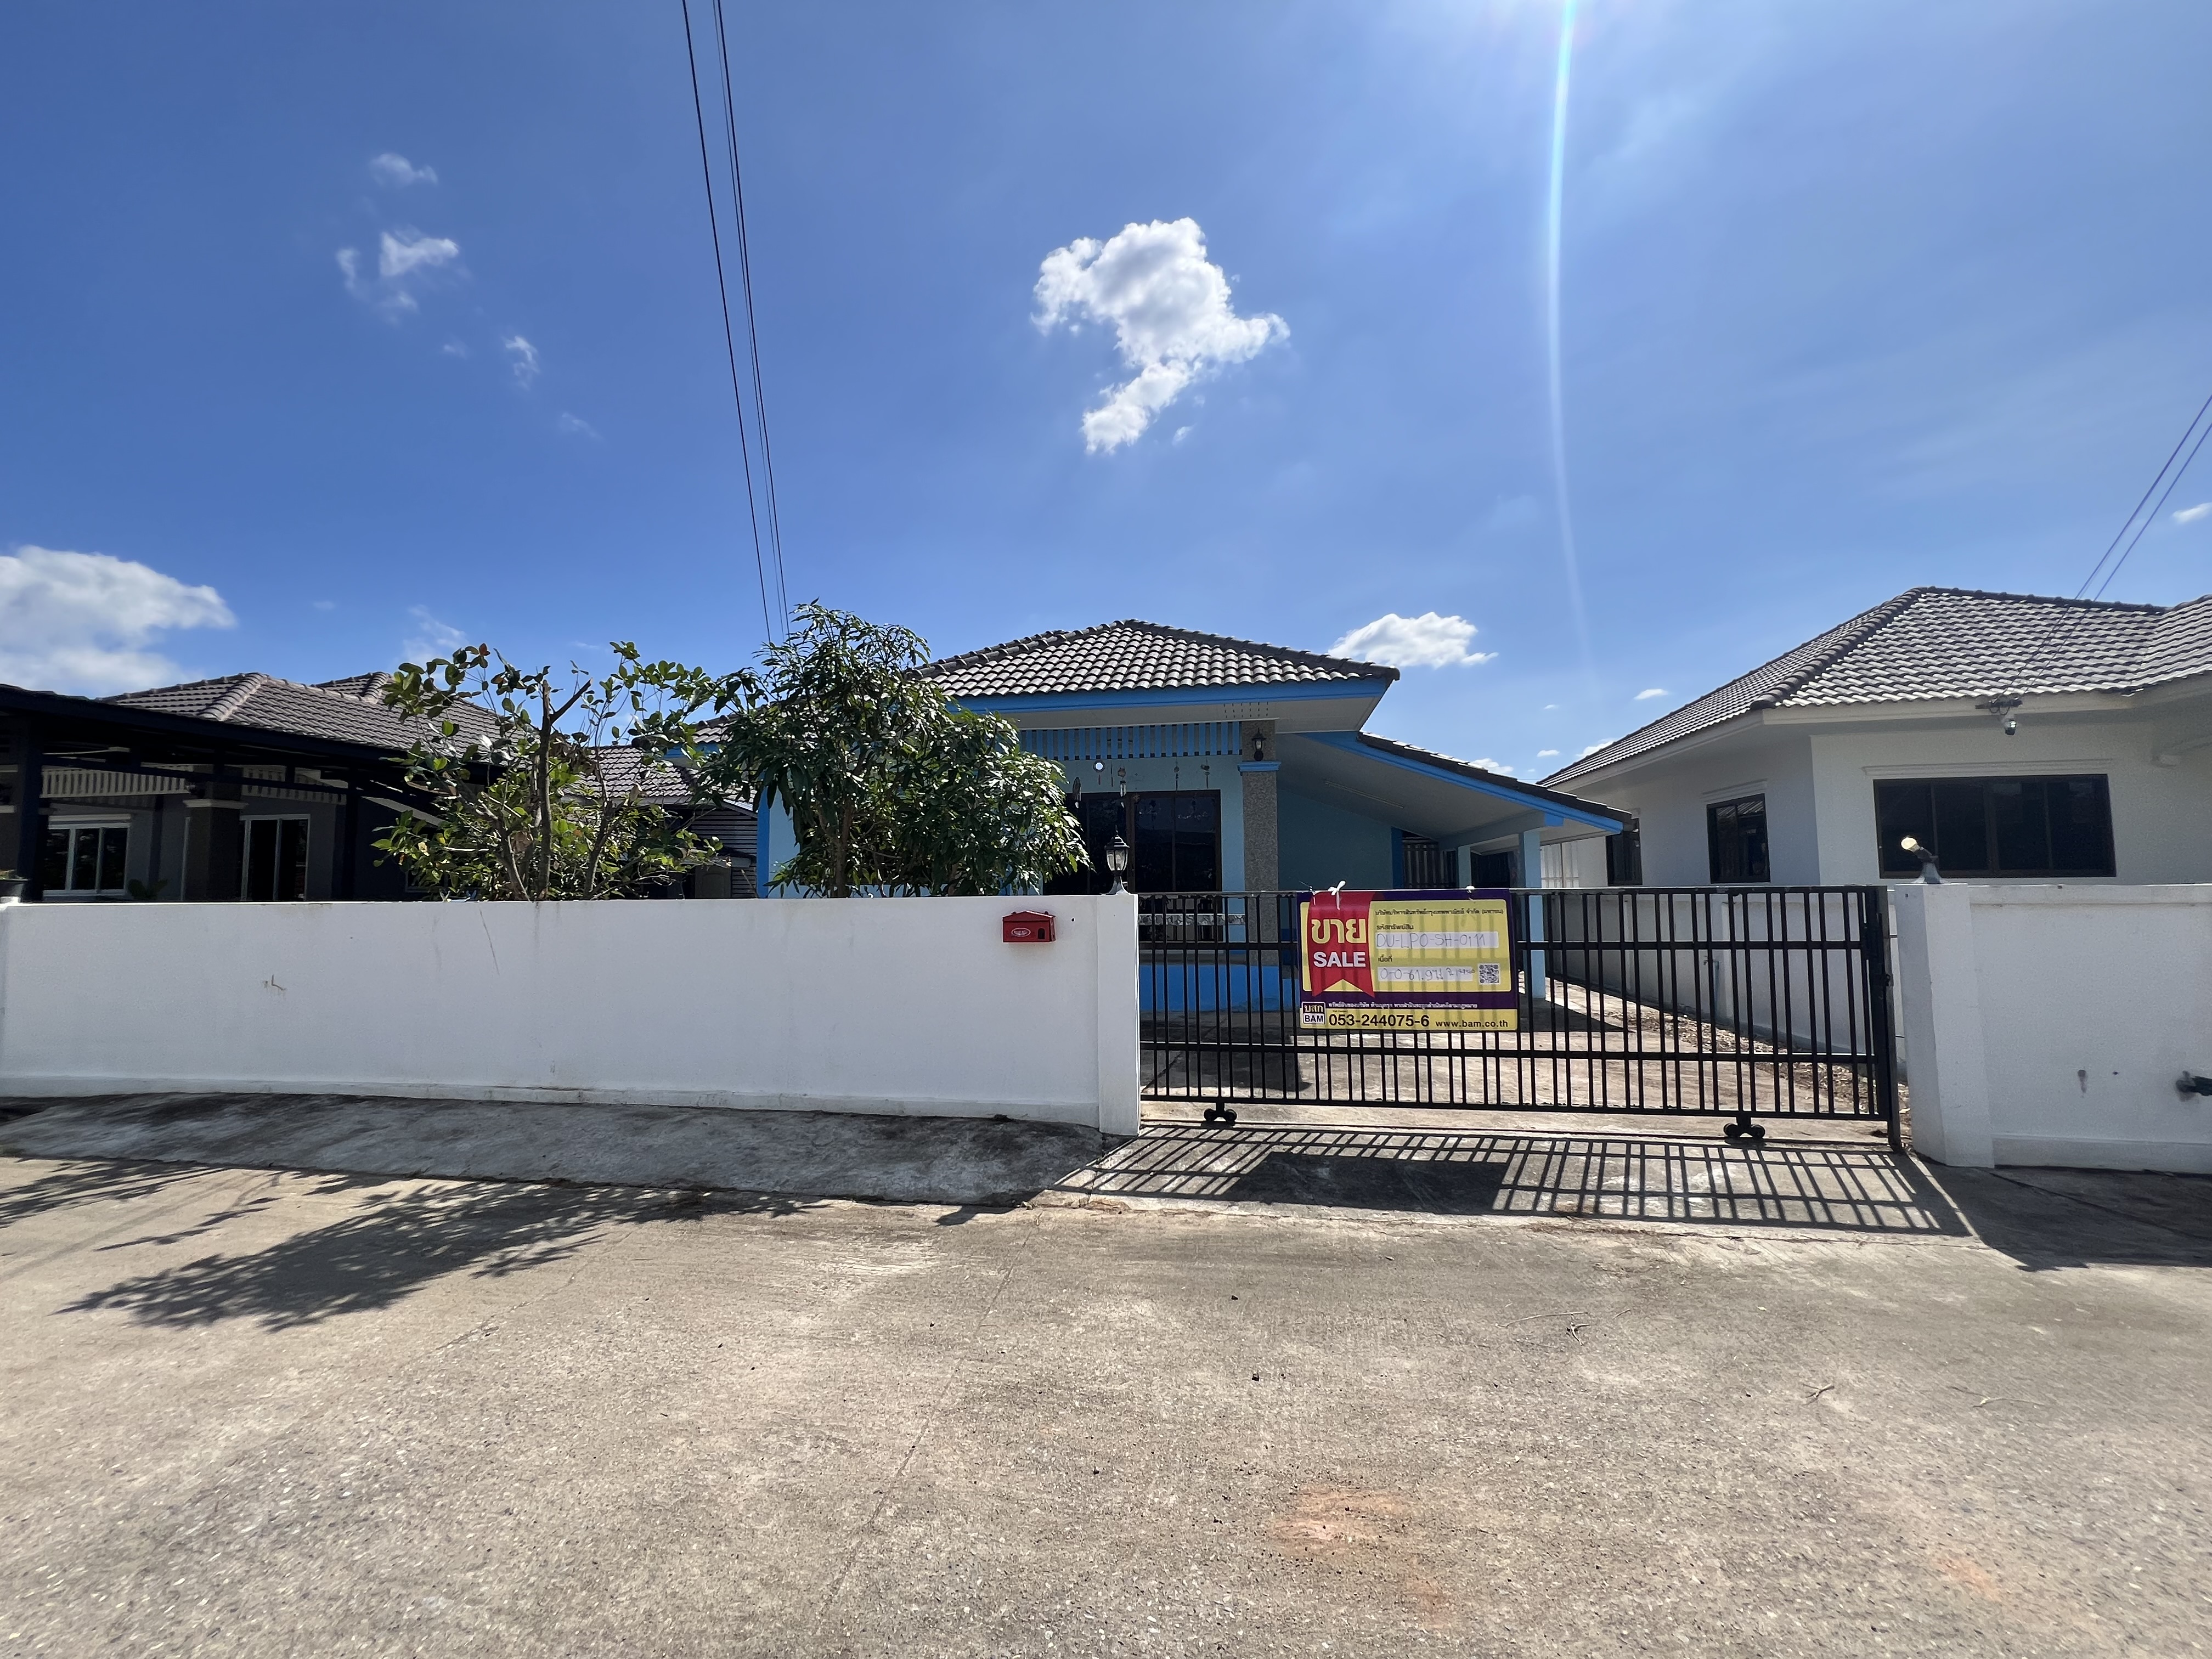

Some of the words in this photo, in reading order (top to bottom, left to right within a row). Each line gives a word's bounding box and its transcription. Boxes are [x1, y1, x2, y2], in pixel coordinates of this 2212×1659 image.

[1311, 918, 1367, 944] ขาย
[1313, 951, 1366, 967] SALE
[1304, 1004, 1323, 1013] บสก
[1329, 1014, 1430, 1027] 053-244075-6
